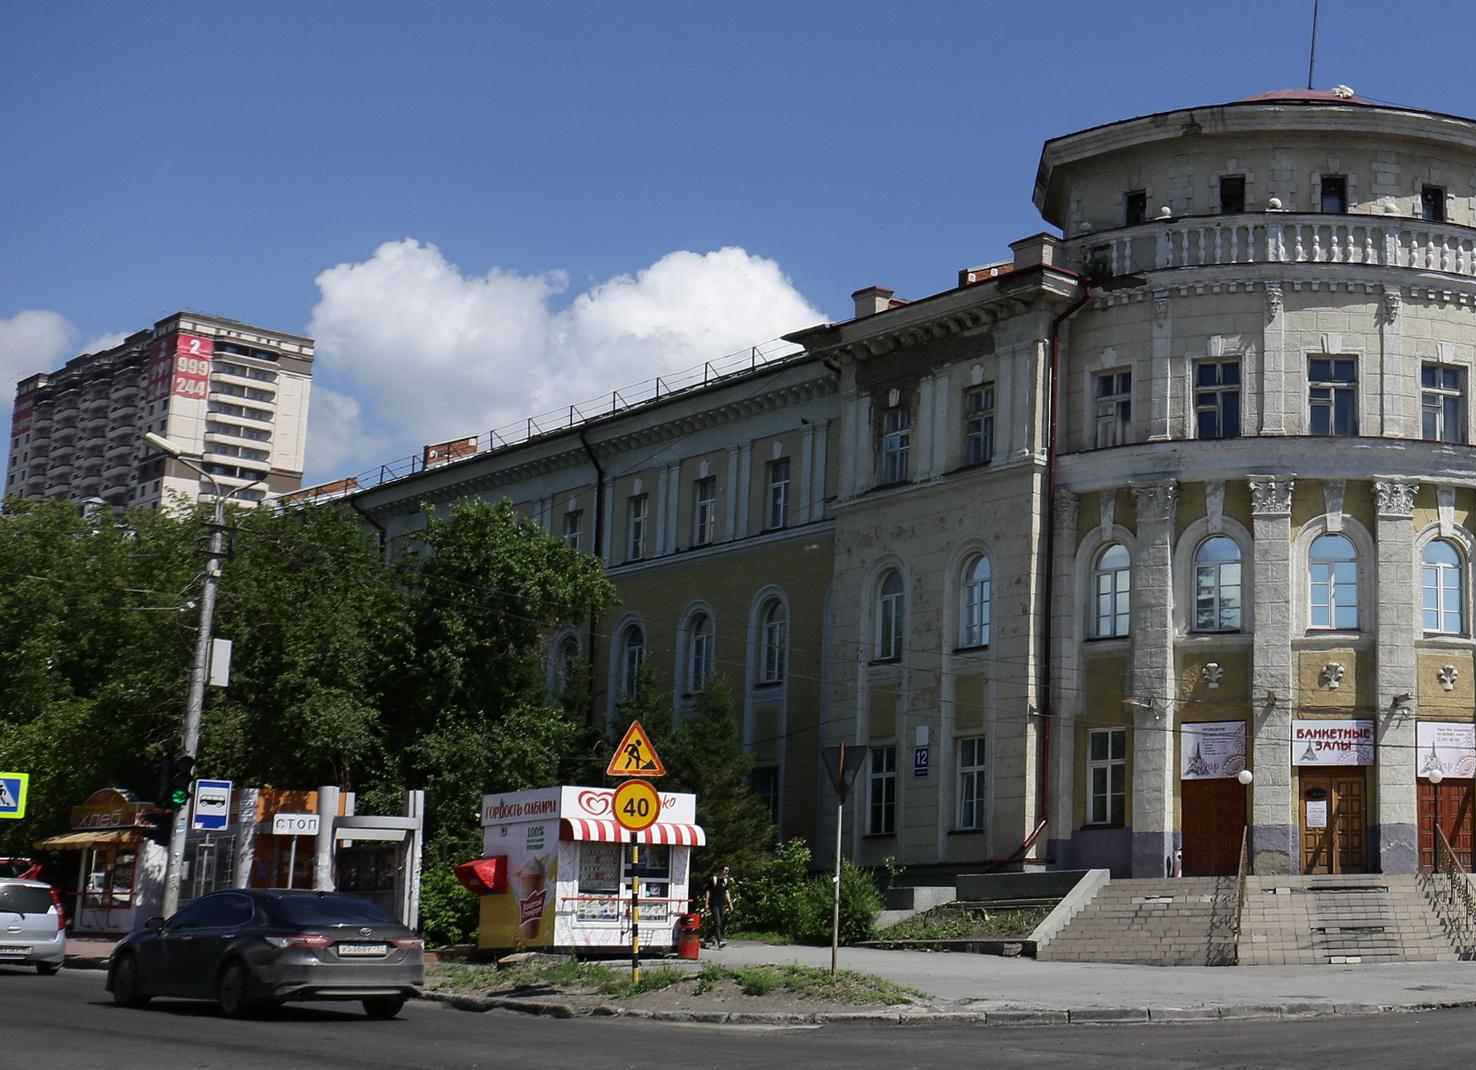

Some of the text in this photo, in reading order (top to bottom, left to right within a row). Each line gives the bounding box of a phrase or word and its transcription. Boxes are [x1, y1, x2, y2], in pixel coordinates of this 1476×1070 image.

[190, 339, 201, 354] 2
[177, 357, 208, 377] 999
[176, 377, 207, 396] 244
[1296, 728, 1370, 739] БАНКЕТНЫЕ
[1315, 740, 1352, 751] ЗАЛЫ
[916, 750, 928, 765] 12
[486, 799, 557, 819] ГОРДОСТЬ СИБИРИ
[623, 797, 649, 817] 40
[276, 818, 316, 830] СТОП
